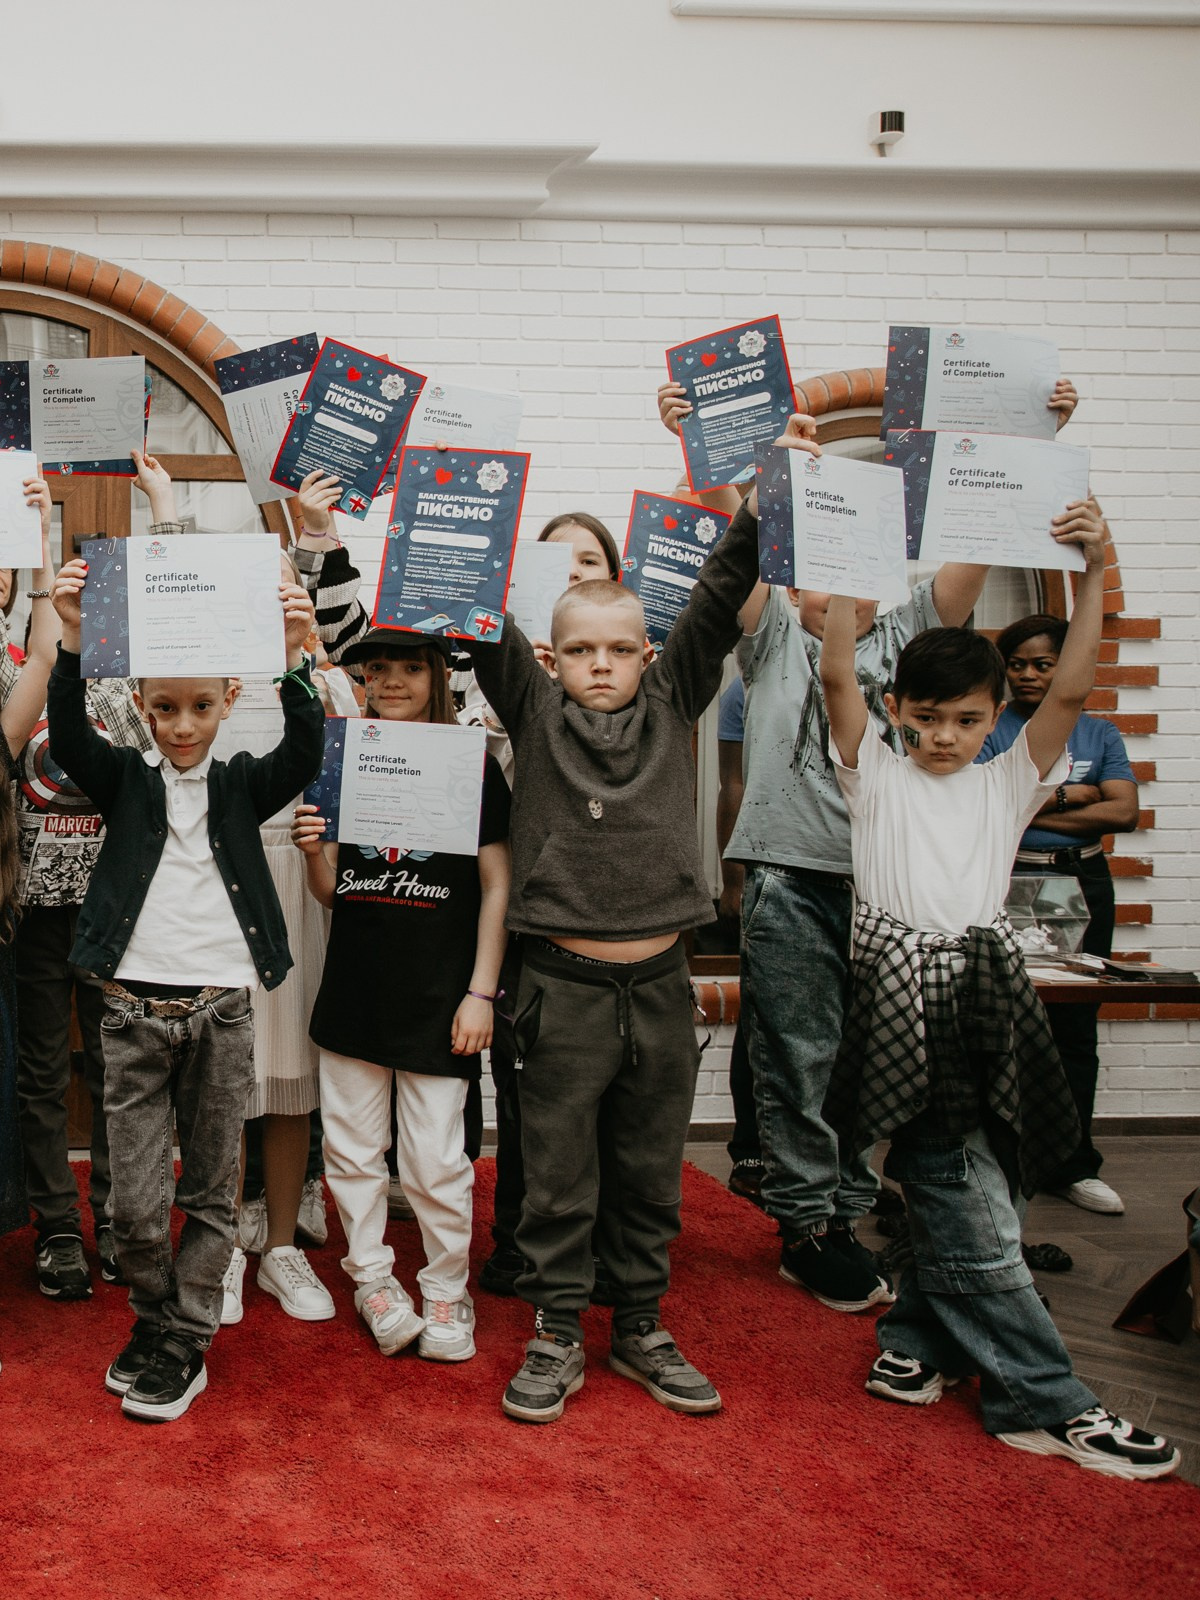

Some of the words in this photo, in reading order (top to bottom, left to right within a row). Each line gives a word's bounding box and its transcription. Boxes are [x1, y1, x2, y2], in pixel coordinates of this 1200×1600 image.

[943, 359, 990, 368] Certificate
[693, 360, 766, 384] БЛАГОДАРСТВЕННОЕ
[954, 370, 1004, 378] Completion
[694, 368, 764, 397] ПИСЬМО
[329, 382, 393, 412] БЛАГОДАРСТВЕННОЕ
[324, 390, 386, 422] ПИСЬМО
[425, 408, 462, 419] Certificate
[432, 416, 472, 429] Completion
[949, 467, 1006, 479] Certificate
[961, 479, 1023, 490] Completion
[418, 493, 500, 506] БЛАГОДАРСТВЕННОЕ
[805, 489, 844, 502] Certificate
[416, 502, 493, 521] ПИСЬМО
[815, 501, 857, 516] Completion
[649, 534, 709, 556] БЛАГОДАРСТВЕННОЕ
[647, 542, 704, 568] ПИСЬМО
[145, 573, 199, 582] Certificate
[146, 585, 155, 593] of
[158, 583, 216, 594] Completion
[359, 753, 407, 764] Certificate
[369, 765, 421, 776] Completion
[48, 817, 96, 832] MARVEL
[336, 869, 395, 894] Sweet
[393, 870, 450, 899] Home
[366, 896, 412, 906] АНГЛИЙСКОГО
